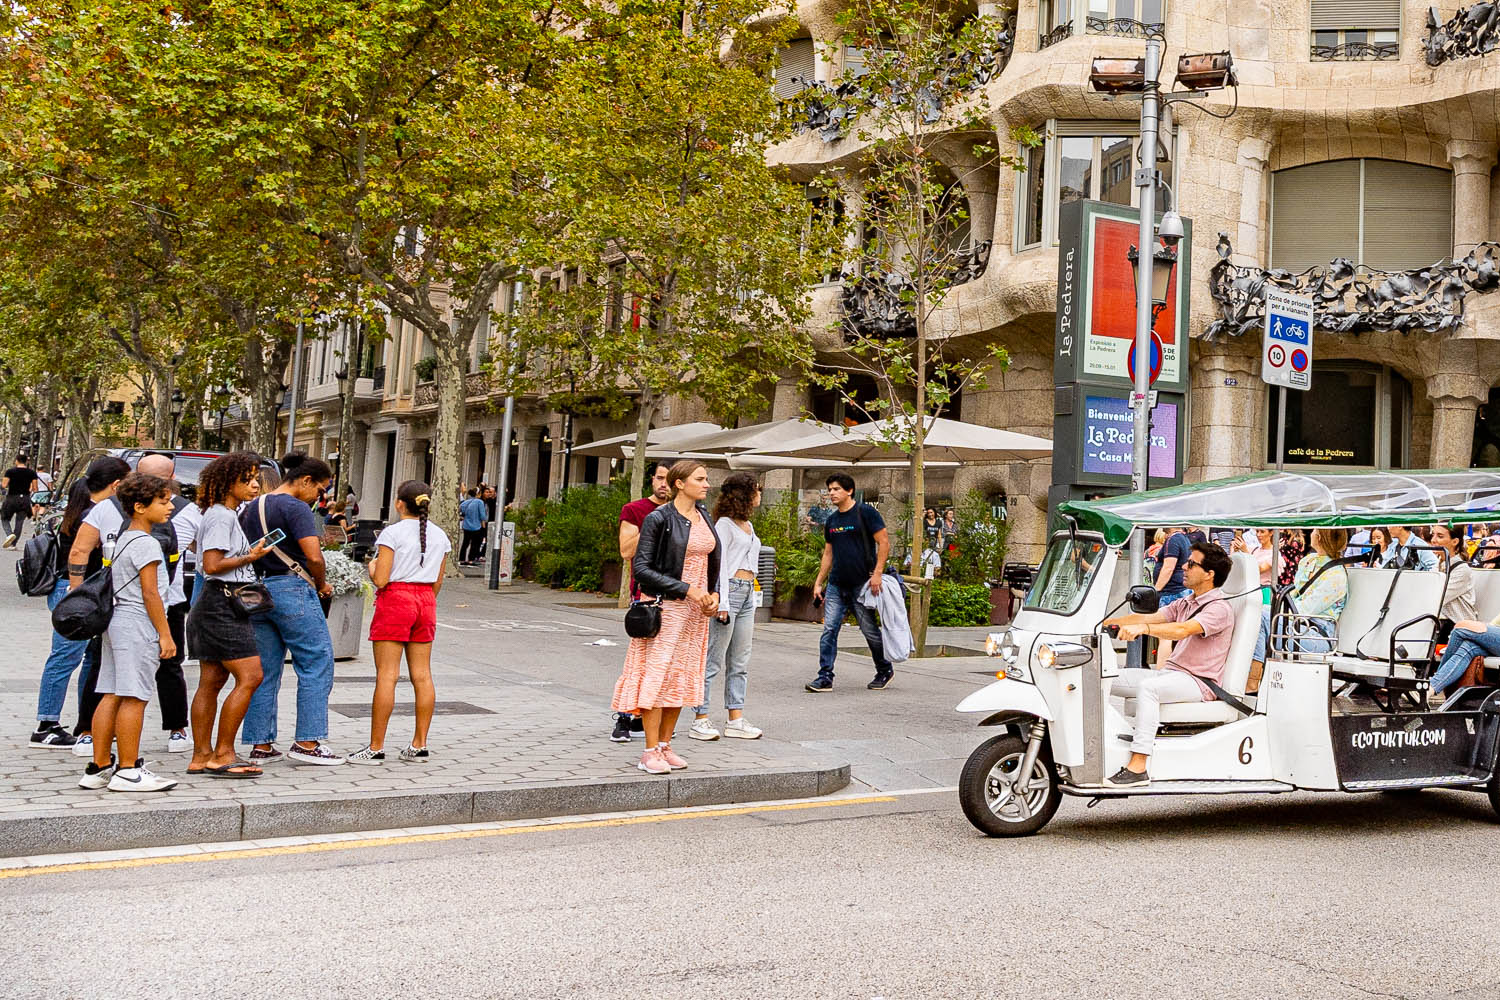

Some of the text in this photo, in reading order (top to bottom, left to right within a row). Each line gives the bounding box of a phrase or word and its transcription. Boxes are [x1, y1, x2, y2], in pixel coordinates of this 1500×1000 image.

[1060, 247, 1075, 356] La Pedrera
[1268, 293, 1282, 303] Zona
[1273, 352, 1281, 360] 10
[1088, 408, 1134, 422] Bienvenid
[1087, 426, 1168, 449] La Pedra
[1099, 451, 1122, 462] Casa
[1305, 448, 1315, 456] de
[1316, 448, 1324, 456] la
[1325, 449, 1354, 457] Pedrera
[1352, 729, 1446, 749] ECOTUKTUK.COM
[1238, 736, 1254, 765] 6
